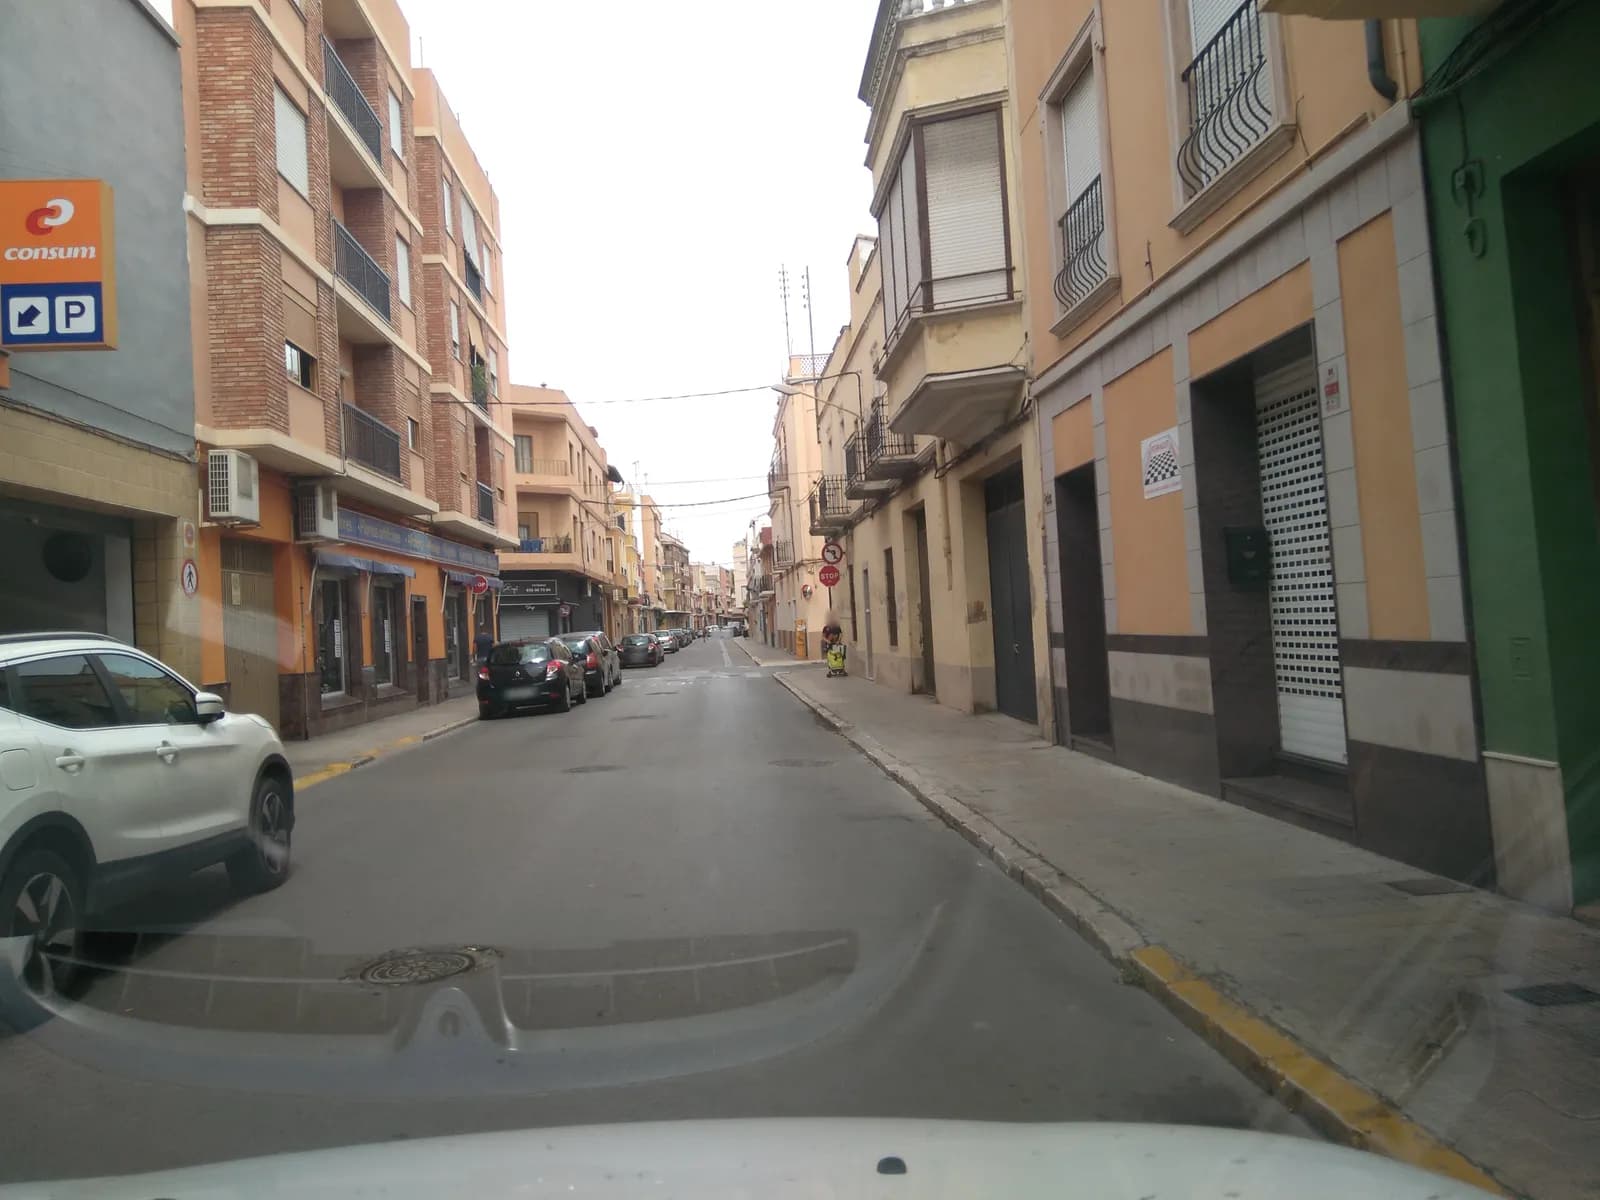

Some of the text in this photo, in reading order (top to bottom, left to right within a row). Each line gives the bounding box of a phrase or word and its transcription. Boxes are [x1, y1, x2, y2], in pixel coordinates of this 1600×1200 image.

[4, 246, 96, 260] consum
[64, 301, 86, 328] P
[820, 572, 839, 580] STOP
